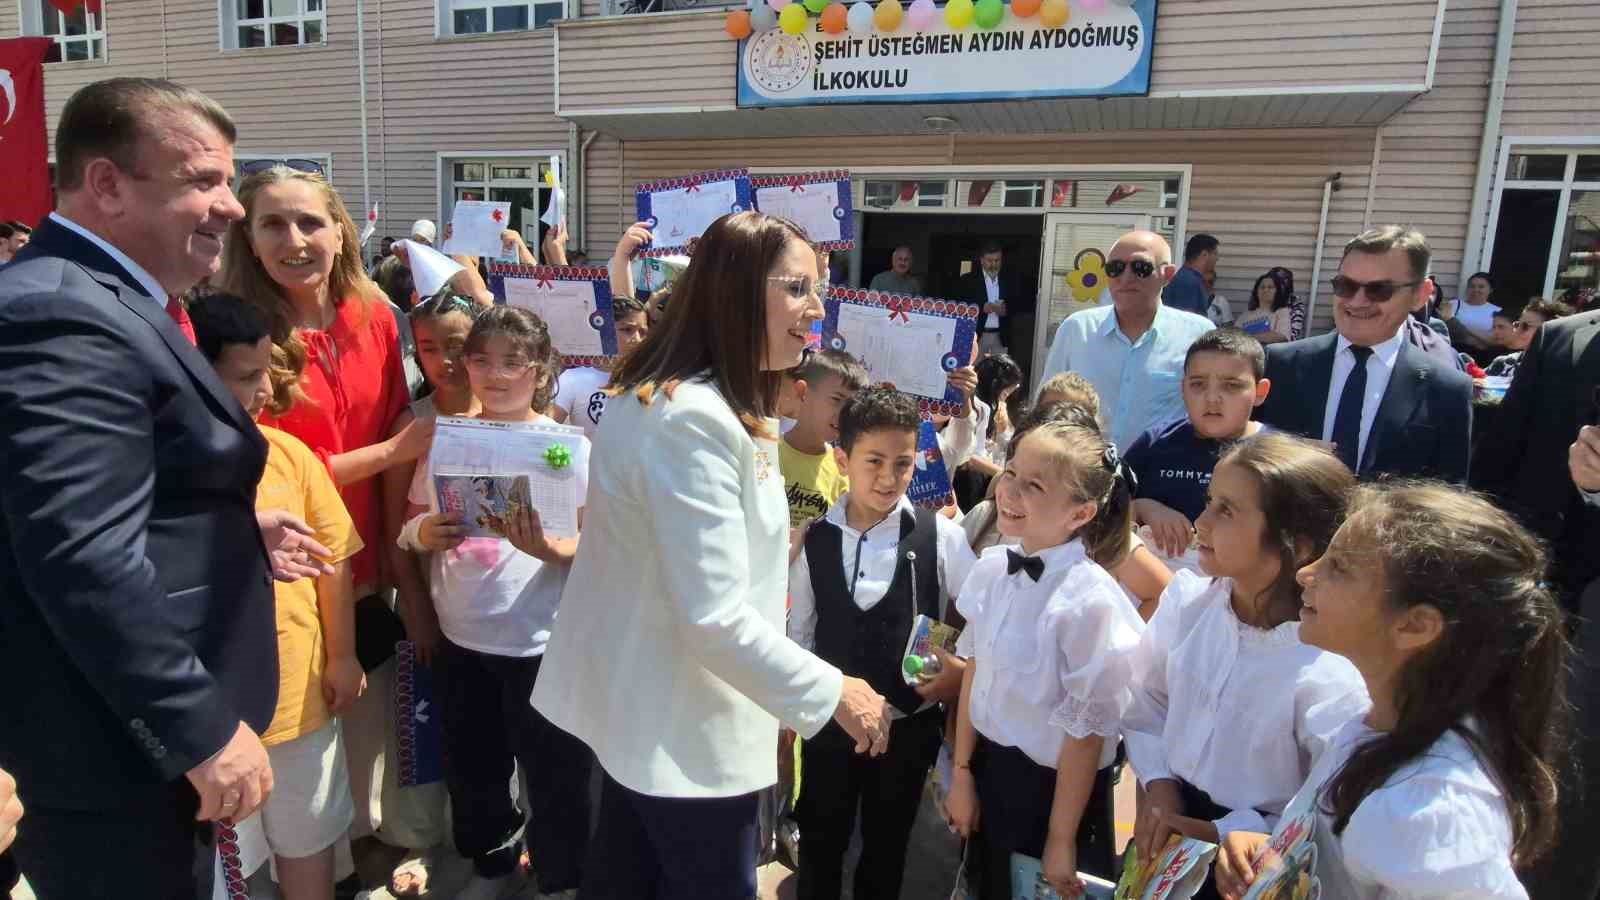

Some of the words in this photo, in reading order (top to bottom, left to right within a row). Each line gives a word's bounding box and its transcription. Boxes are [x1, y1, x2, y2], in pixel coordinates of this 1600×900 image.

[814, 35, 863, 64] ŞEHİT
[869, 31, 963, 58] ÜSTEĞMEN
[968, 30, 1024, 53] AYDIN
[1029, 22, 1139, 51] AYDOĞMUŞ
[813, 69, 908, 91] İLKOKULU
[1160, 469, 1203, 480] TOMMY
